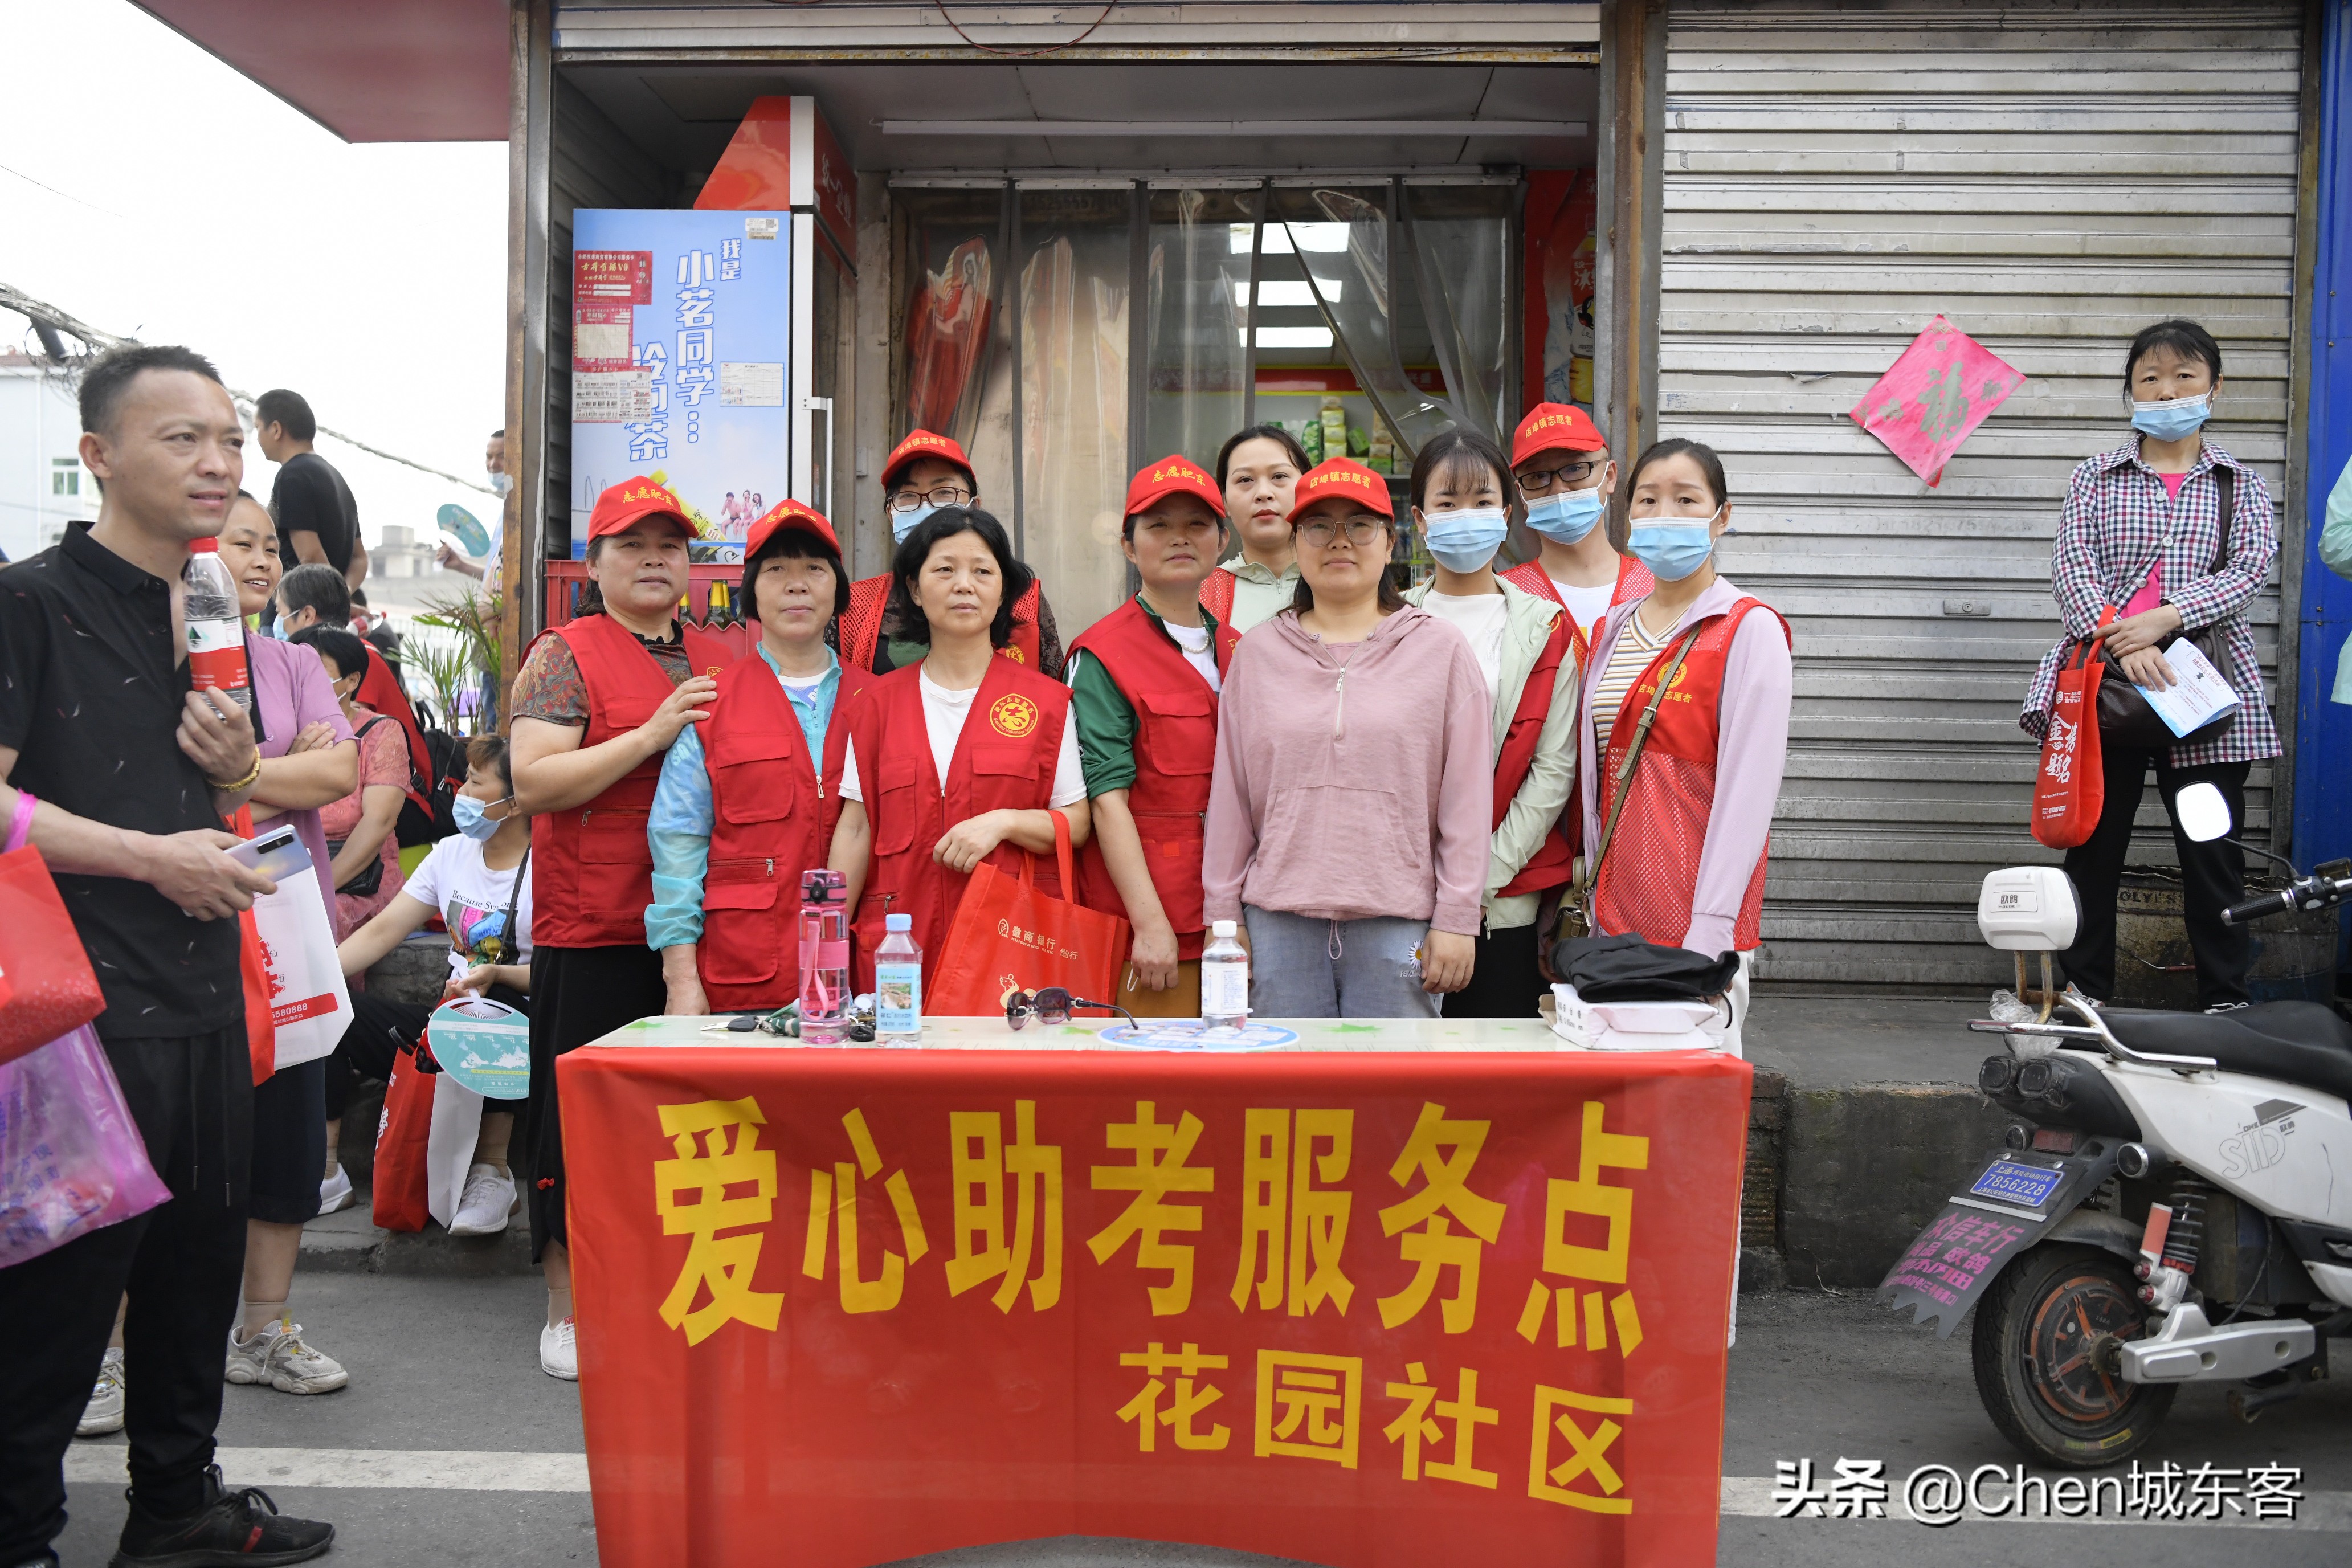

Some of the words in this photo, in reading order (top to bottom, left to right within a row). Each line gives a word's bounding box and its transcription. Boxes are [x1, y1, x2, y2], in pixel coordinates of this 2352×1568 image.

[720, 238, 741, 281] 我是
[1917, 361, 1969, 443] 福
[1525, 414, 1573, 438] 店埠镇志愿者
[898, 437, 946, 456] 店埠镇志愿者
[1152, 466, 1206, 487] 志愿肥东
[1310, 472, 1371, 489] 店埠镇志愿者
[623, 487, 674, 507] 志愿肥东
[452, 889, 483, 908] Because
[2001, 895, 2018, 904] 欧鸽
[1011, 937, 1039, 949] HUISHANG
[1012, 926, 1056, 950] 徽商银行
[1994, 1165, 2013, 1175] 上海
[2012, 1169, 2052, 1182] 两轮电动自行车
[1984, 1174, 2047, 1197] 7856228
[655, 1095, 1650, 1358] 爱心助考服务点
[1116, 1341, 1635, 1515] 花园社区
